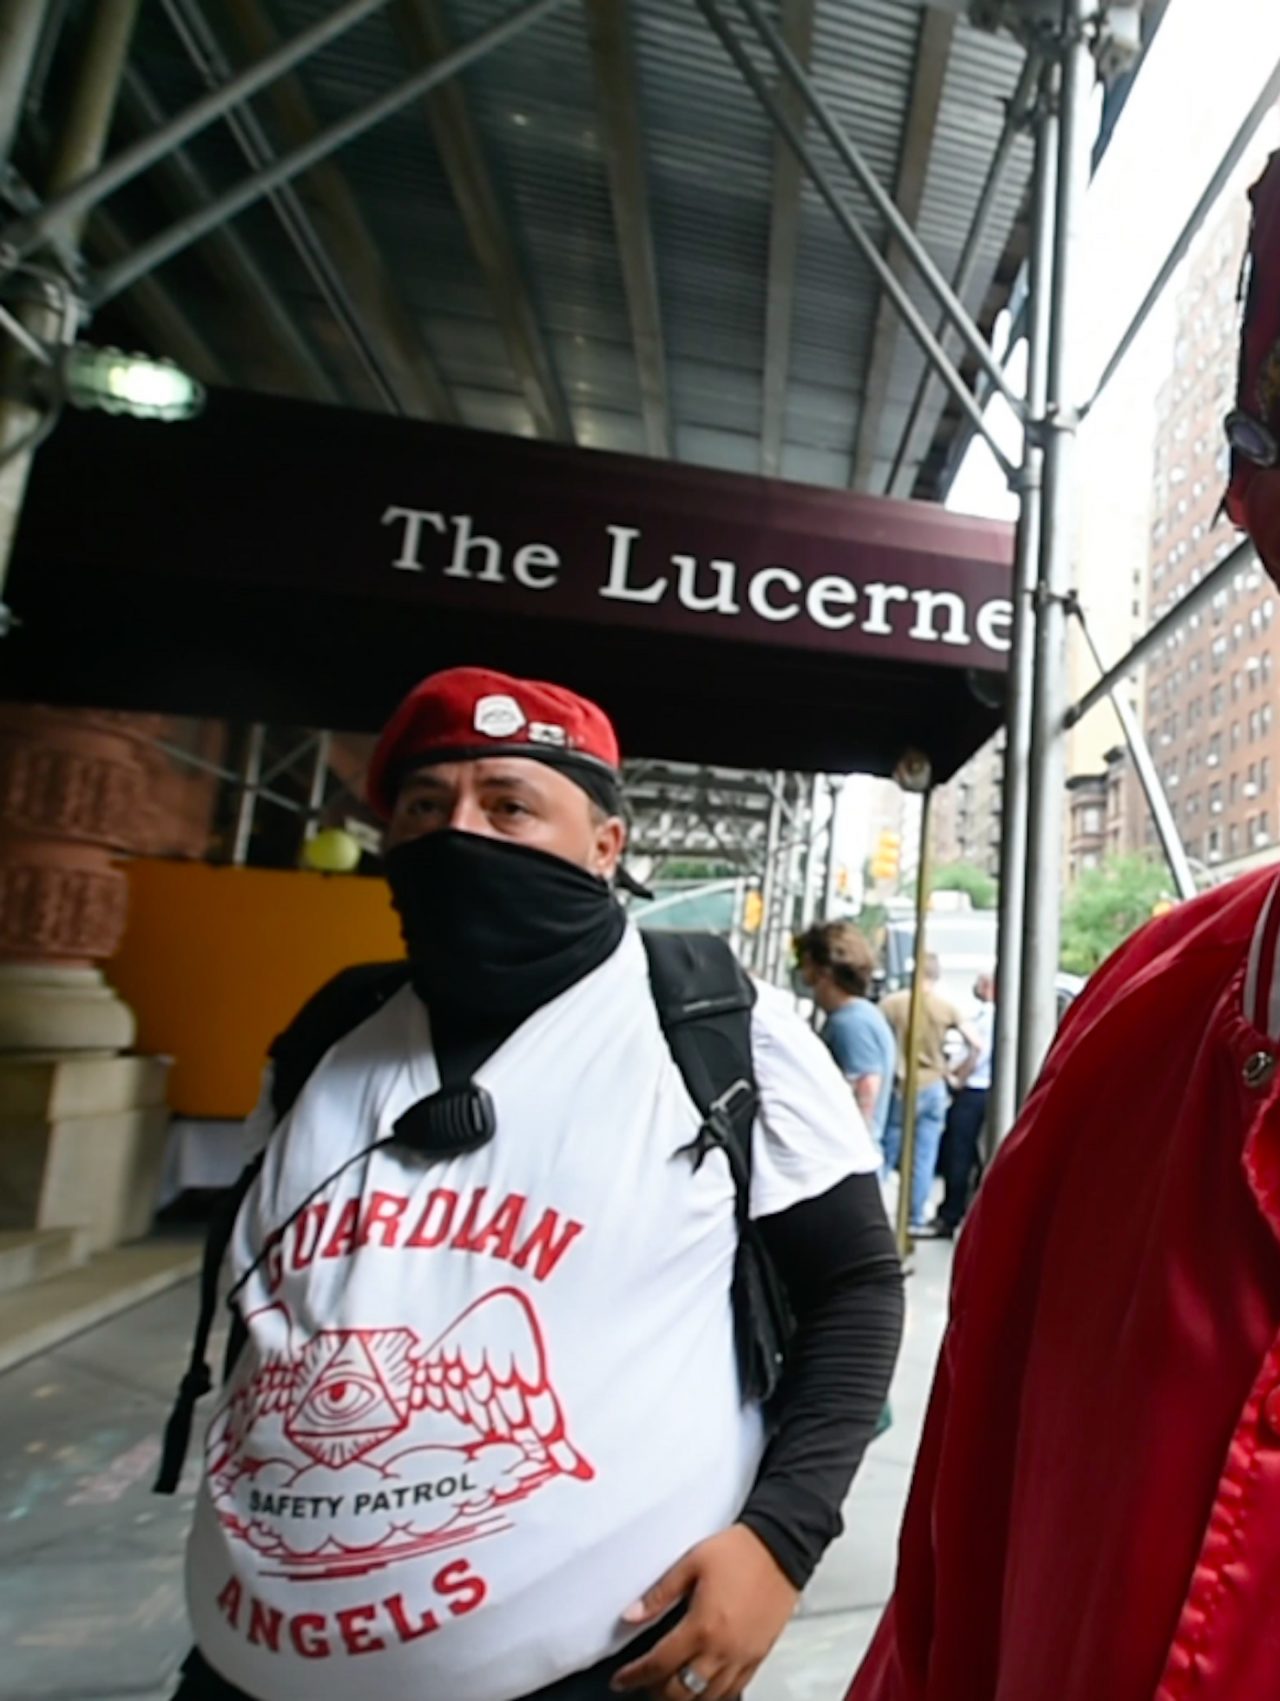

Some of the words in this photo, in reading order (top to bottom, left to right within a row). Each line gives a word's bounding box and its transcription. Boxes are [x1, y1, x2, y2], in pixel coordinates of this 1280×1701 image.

[382, 506, 560, 589] The
[599, 525, 1014, 652] Lucerne
[249, 1489, 344, 1519] SAFETY
[354, 1473, 477, 1515] PATROL
[217, 1558, 487, 1660] ANGELS
